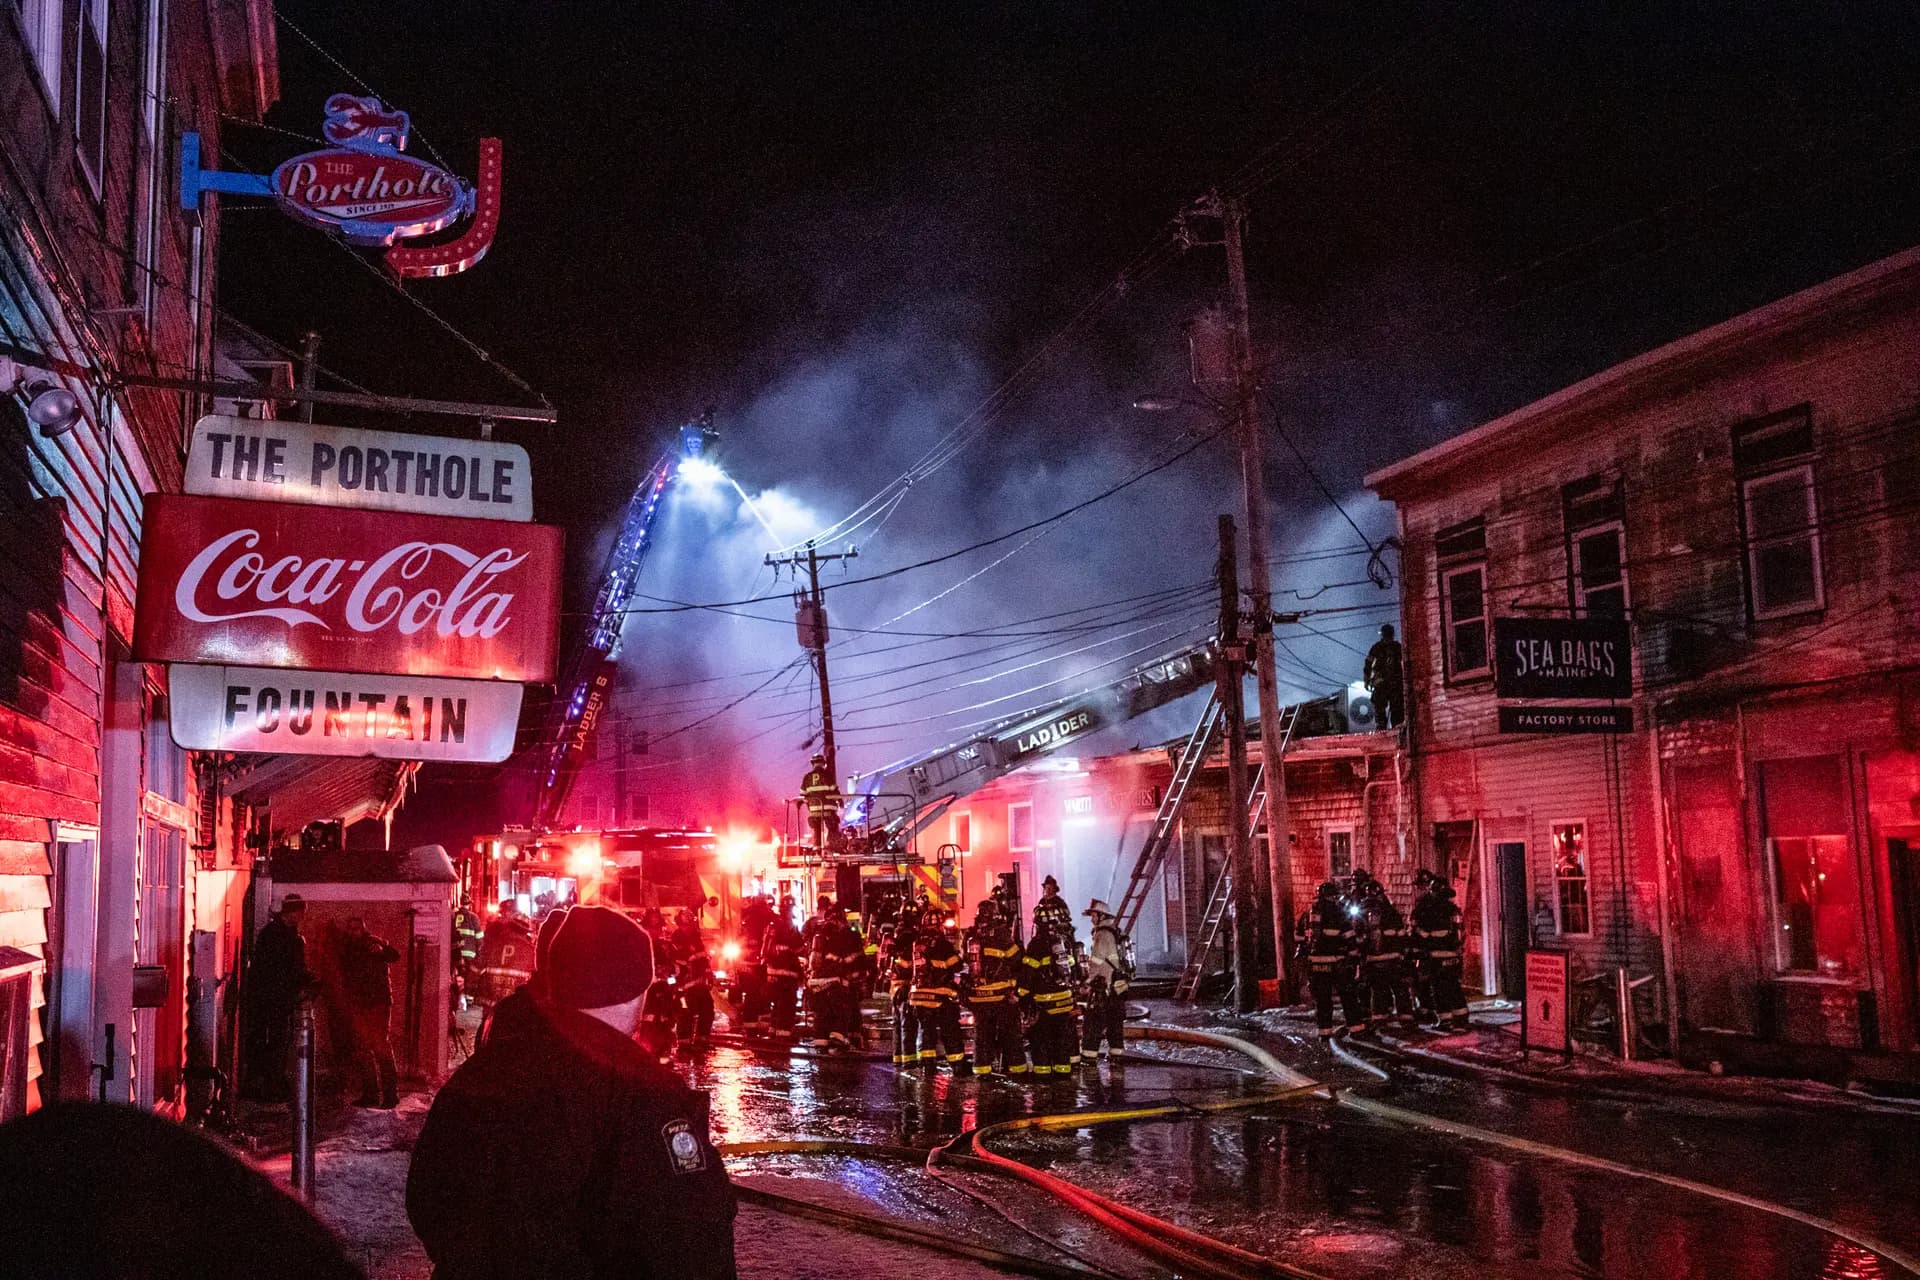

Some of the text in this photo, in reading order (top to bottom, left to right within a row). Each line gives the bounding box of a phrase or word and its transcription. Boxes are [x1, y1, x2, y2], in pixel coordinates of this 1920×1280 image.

[286, 163, 452, 203] Porthole
[326, 162, 354, 174] THE
[346, 206, 376, 215] SINCE
[206, 433, 514, 504] THE PORTHOLE
[175, 528, 530, 639] Coca-Cola
[1515, 639, 1615, 678] SEA BAGS
[225, 686, 467, 745] FOUNTAIN
[573, 692, 600, 751] LADDER
[1518, 715, 1617, 725] FACTORY STORE
[812, 773, 820, 785] P
[501, 944, 515, 965] P
